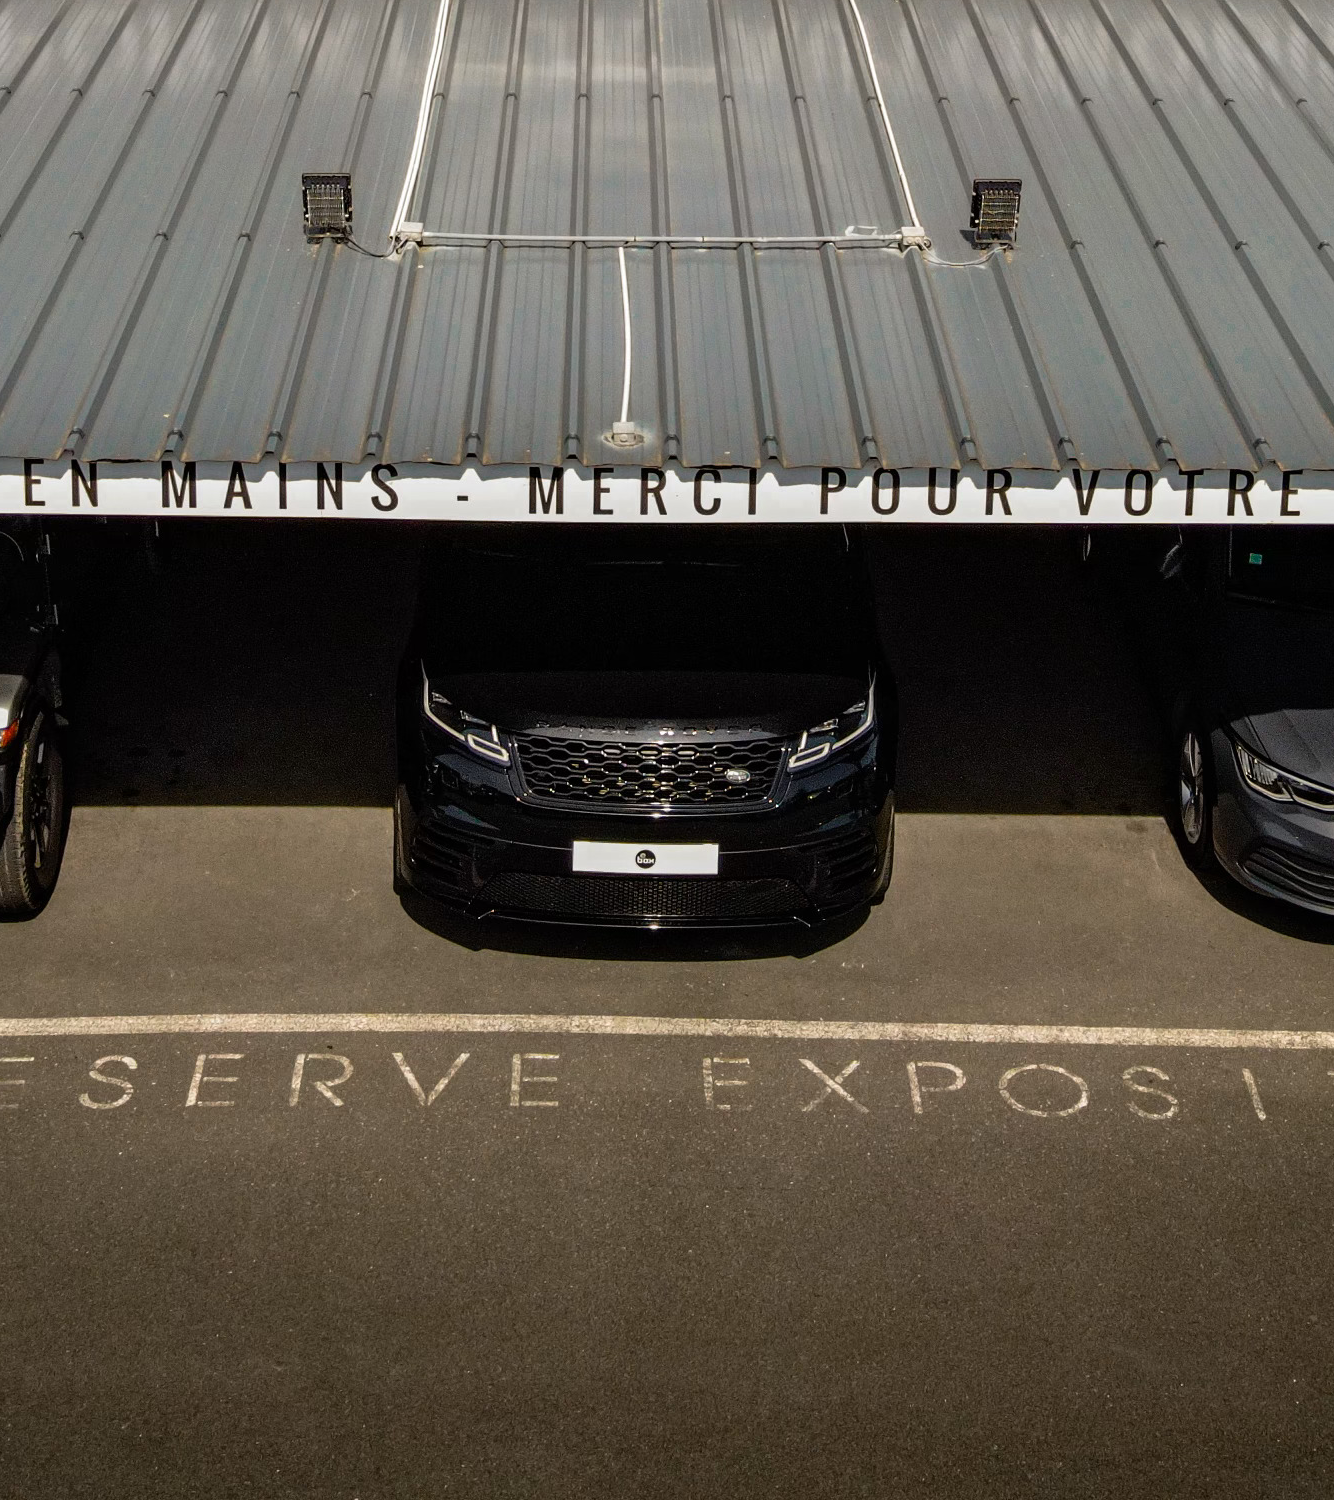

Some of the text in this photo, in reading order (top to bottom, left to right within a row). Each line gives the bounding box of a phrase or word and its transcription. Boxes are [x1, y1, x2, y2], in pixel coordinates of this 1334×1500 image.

[24, 459, 98, 508] EN
[161, 461, 399, 512] MAINS
[528, 466, 757, 516] MERCI
[820, 467, 1013, 517] POUR
[1071, 469, 1302, 518] VOTRE
